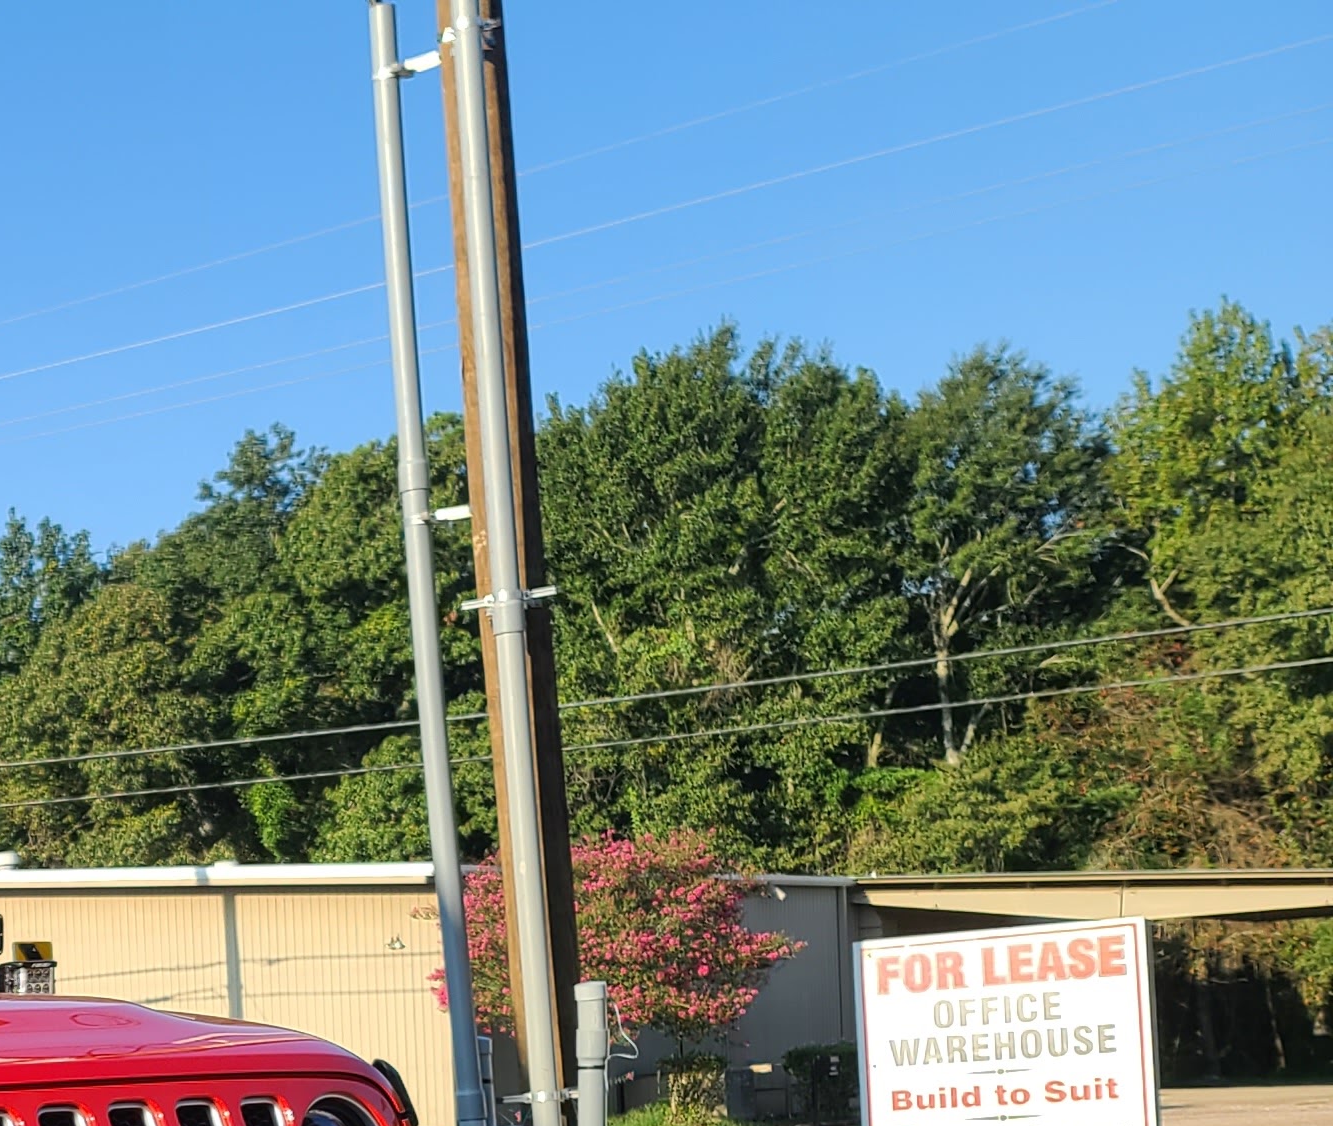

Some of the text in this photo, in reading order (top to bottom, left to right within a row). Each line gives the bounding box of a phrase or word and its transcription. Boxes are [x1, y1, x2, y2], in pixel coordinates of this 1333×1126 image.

[876, 934, 1128, 996] FOR LEASE
[933, 991, 1062, 1029] OFFICE
[888, 1023, 1118, 1067] WAREHOUSE
[891, 1077, 1120, 1111] Build to Suit
